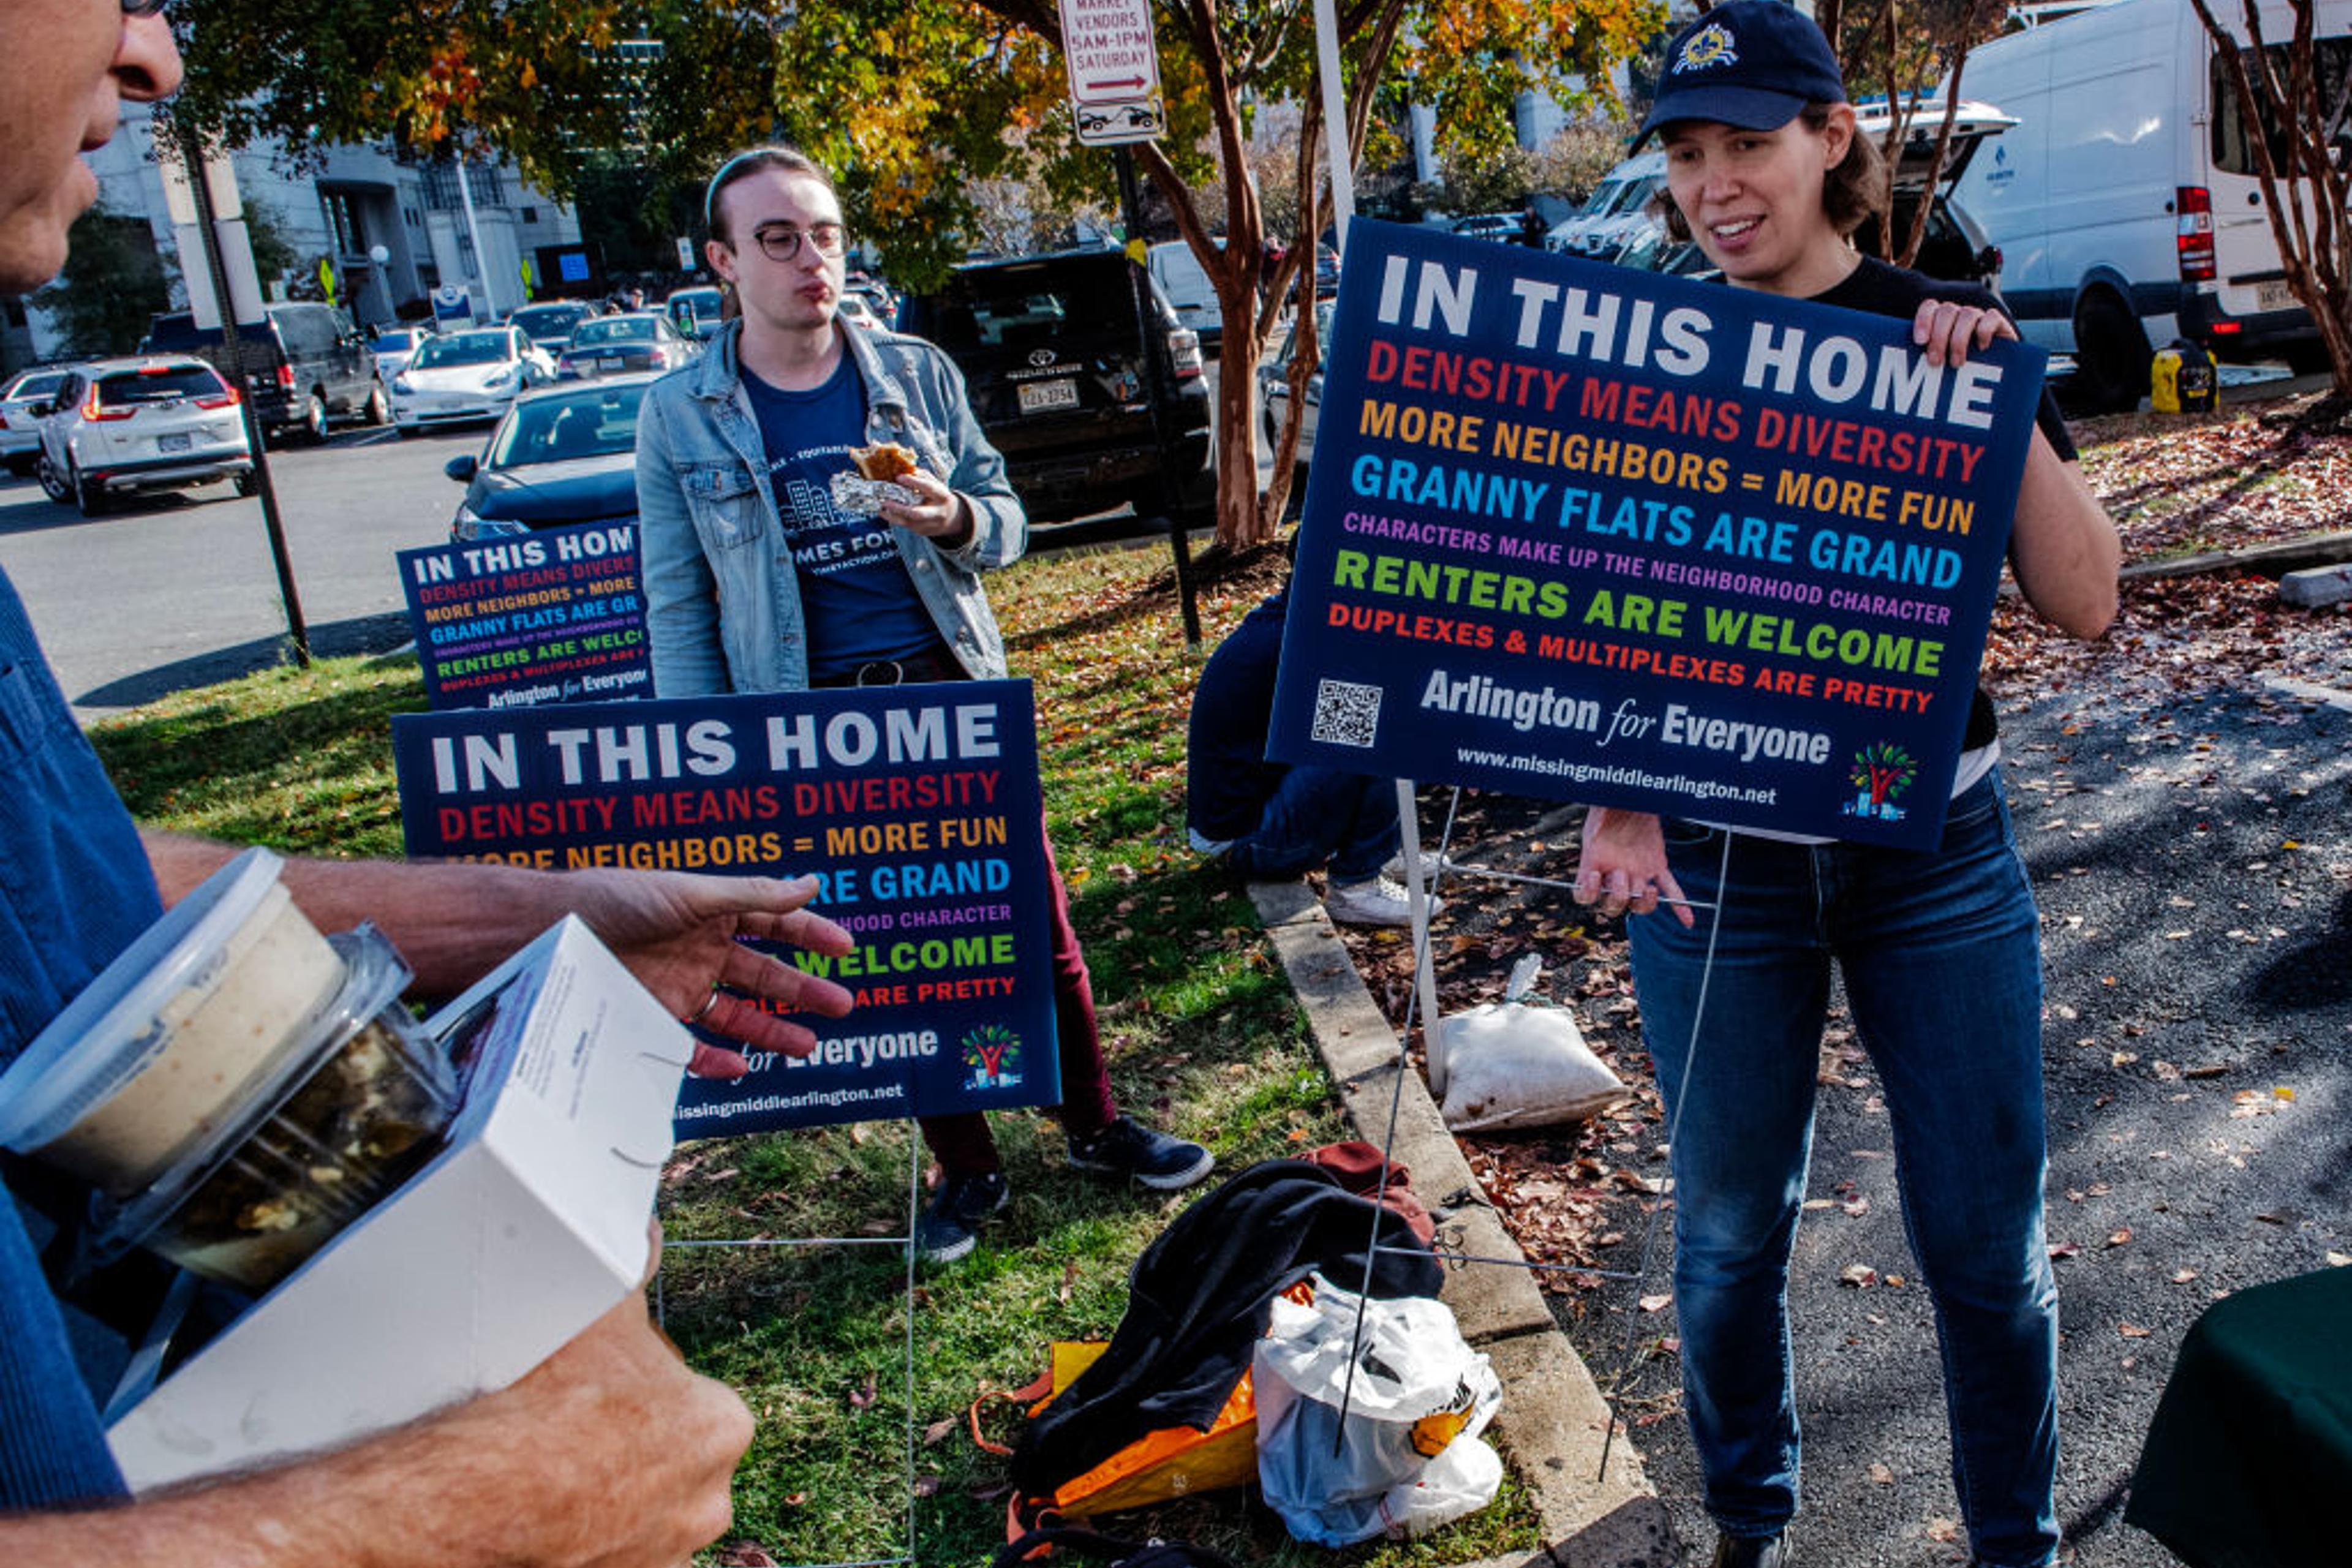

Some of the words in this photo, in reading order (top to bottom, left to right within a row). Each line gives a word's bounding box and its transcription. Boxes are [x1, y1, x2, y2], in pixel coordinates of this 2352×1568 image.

[1072, 31, 1147, 51] 5AM-1PM
[1075, 12, 1137, 30] VENDORS
[1076, 51, 1146, 70] SATURDAY
[1378, 255, 1477, 336] IN
[1513, 278, 1713, 375] THIS
[1743, 322, 2003, 429] HOME
[1368, 342, 1568, 410] DENSITY
[1581, 379, 1740, 440] MEANS
[1757, 409, 1984, 481] DIVERSITY
[1360, 400, 1483, 451] MORE
[1493, 422, 1728, 492] NEIGHBORS
[1742, 474, 1763, 489] =
[1776, 470, 1890, 520] MORE
[1899, 491, 1973, 533] FUN
[1352, 455, 1548, 521] GRANNY
[1560, 488, 1694, 545] FLATS
[1705, 514, 1798, 562] ARE
[1811, 530, 1961, 587] GRAND
[413, 554, 454, 584] IN
[462, 540, 546, 576] THIS
[420, 578, 496, 604] DENSITY
[502, 565, 567, 591] MEANS
[1344, 512, 1491, 552] CHARACTERS
[1498, 535, 1562, 564] MAKE
[1568, 548, 1598, 568] UP
[1605, 552, 1645, 577] THE
[1650, 560, 1823, 604] NEIGHBORHOOD
[1829, 589, 1951, 625] CHARACTER
[425, 603, 474, 623] MORE
[477, 587, 571, 614] NEIGHBORS
[589, 576, 636, 595] MORE
[430, 616, 507, 644] GRANNY
[511, 606, 567, 631] FLATS
[571, 600, 608, 621] ARE
[1335, 550, 1568, 617] RENTERS
[1585, 590, 1686, 637] ARE
[1706, 607, 1943, 676] WELCOME
[437, 649, 531, 677] RENTERS
[537, 639, 578, 660] ARE
[582, 630, 643, 651] WELC
[1328, 603, 1493, 648] DUPLEXES
[1504, 630, 1527, 654] &
[1538, 635, 1745, 686] MULTIPLEXES
[1754, 668, 1816, 696] ARE
[1823, 678, 1933, 714] PRETTY
[488, 685, 560, 709] Arlington
[560, 679, 581, 703] for
[1421, 670, 1600, 733] Arlington
[1596, 699, 1656, 747] for
[1660, 704, 1830, 764] Everyone
[433, 734, 520, 793] IN
[548, 720, 736, 785] THIS
[767, 703, 1000, 771] HOME
[1457, 748, 1777, 805] www.missingmiddlearlington.net
[439, 797, 616, 841] DENSITY
[634, 786, 778, 827] MEANS
[795, 772, 1001, 815] DIVERSITY
[567, 832, 782, 870] NEIGHBORS
[795, 839, 813, 851] =
[827, 822, 929, 856] MORE
[941, 816, 1008, 848] FUN
[784, 869, 859, 905] RE
[870, 859, 1011, 899] GRAND
[900, 905, 1011, 928] CHARACTER
[794, 935, 1016, 978] WELCOME
[854, 984, 910, 1006] ARE
[918, 977, 1015, 1004] PRETTY
[676, 1084, 904, 1120] issingmiddlearlington.net
